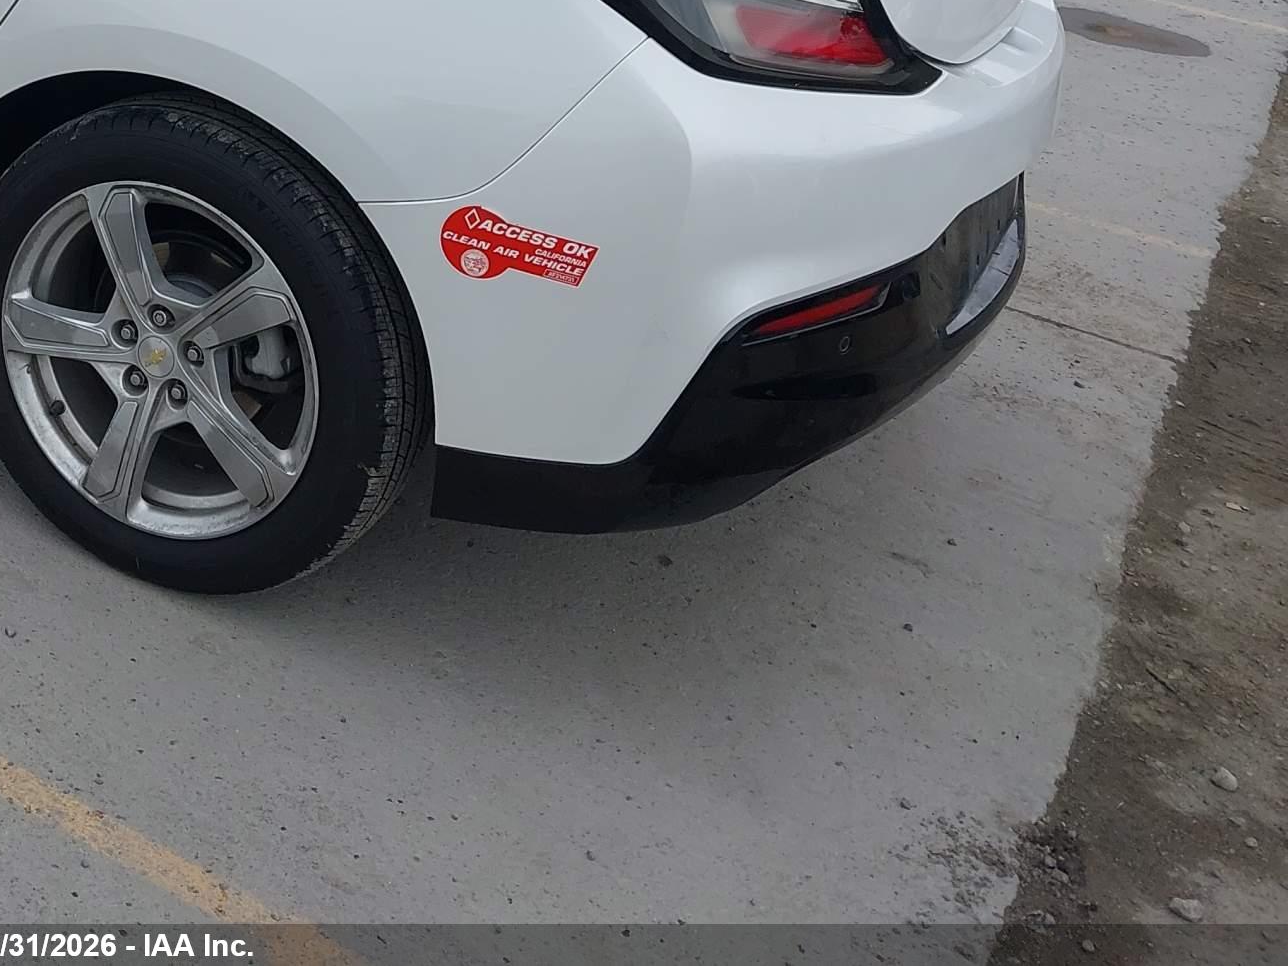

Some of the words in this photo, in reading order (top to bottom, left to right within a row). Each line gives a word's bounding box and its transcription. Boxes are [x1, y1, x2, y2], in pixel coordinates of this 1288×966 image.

[443, 231, 490, 250] CLEAN
[494, 246, 519, 259] AIR
[524, 254, 585, 276] VEHICLE
[479, 219, 558, 249] ACCESS
[563, 243, 594, 259] OK
[535, 249, 586, 267] CALIFORNIA
